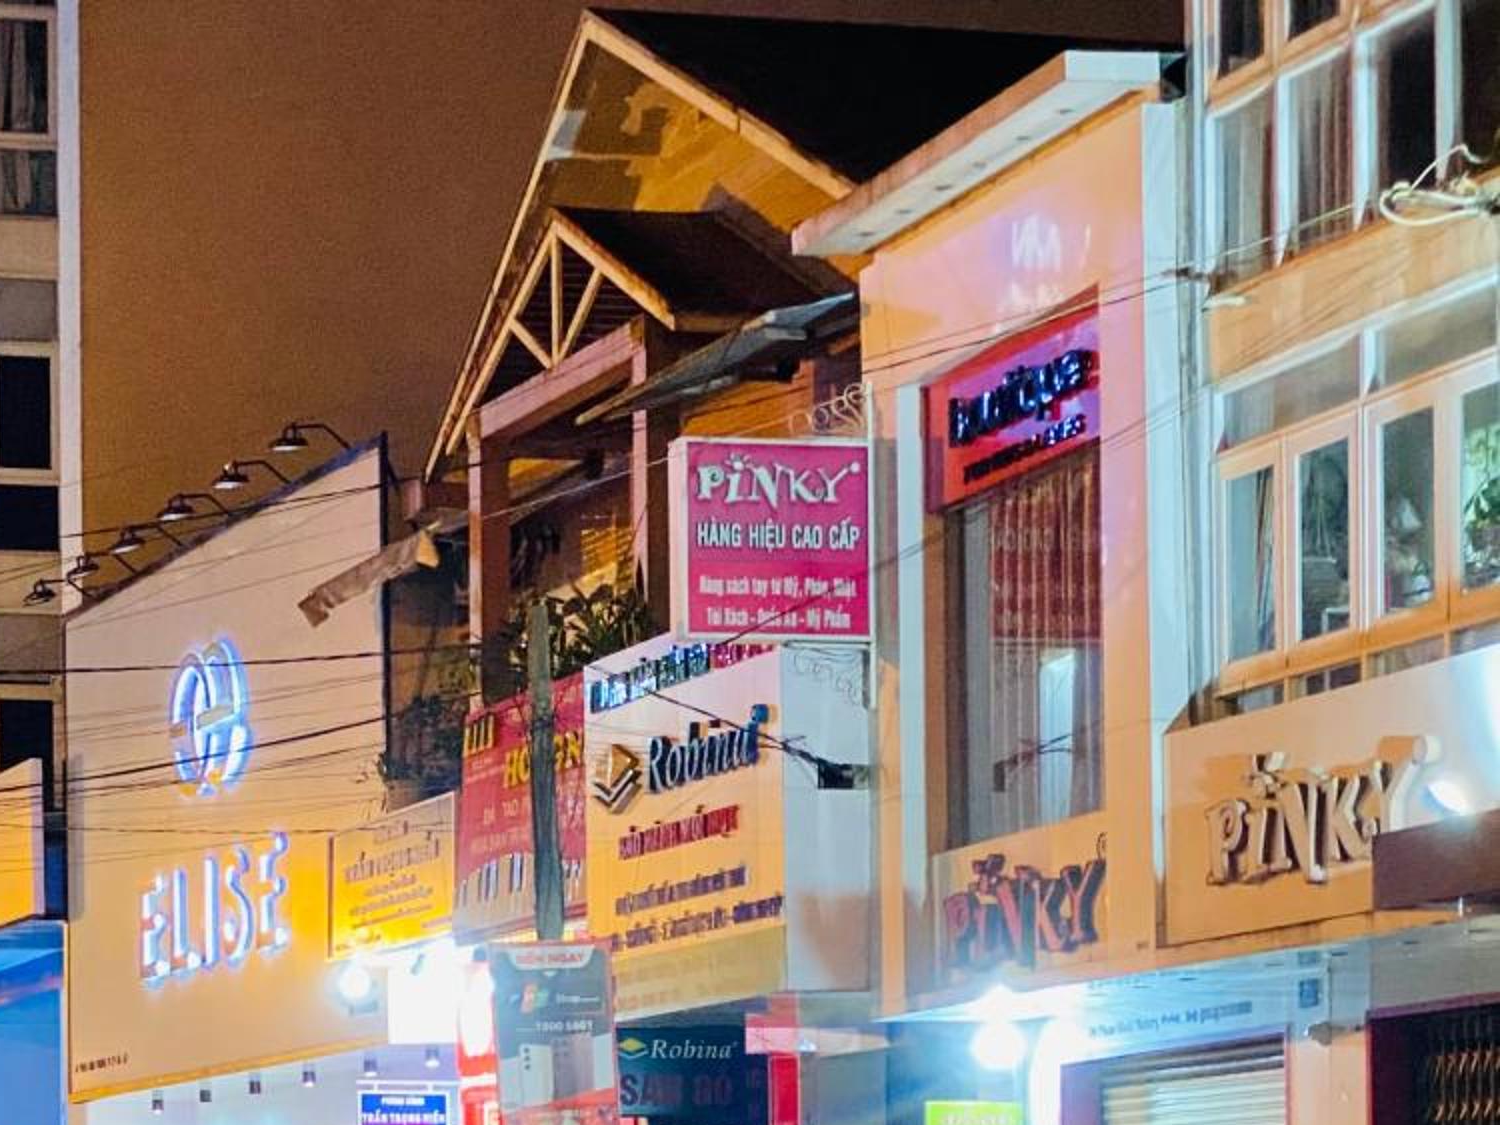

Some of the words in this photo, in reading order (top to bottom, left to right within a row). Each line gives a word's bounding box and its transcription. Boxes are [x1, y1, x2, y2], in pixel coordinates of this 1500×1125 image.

[697, 516, 741, 548] HÀNG
[750, 518, 785, 553] HIỆU
[792, 524, 823, 550] CAO
[829, 517, 860, 551] CẤP
[141, 831, 290, 985] ELISE
[650, 1038, 732, 1060] Robina
